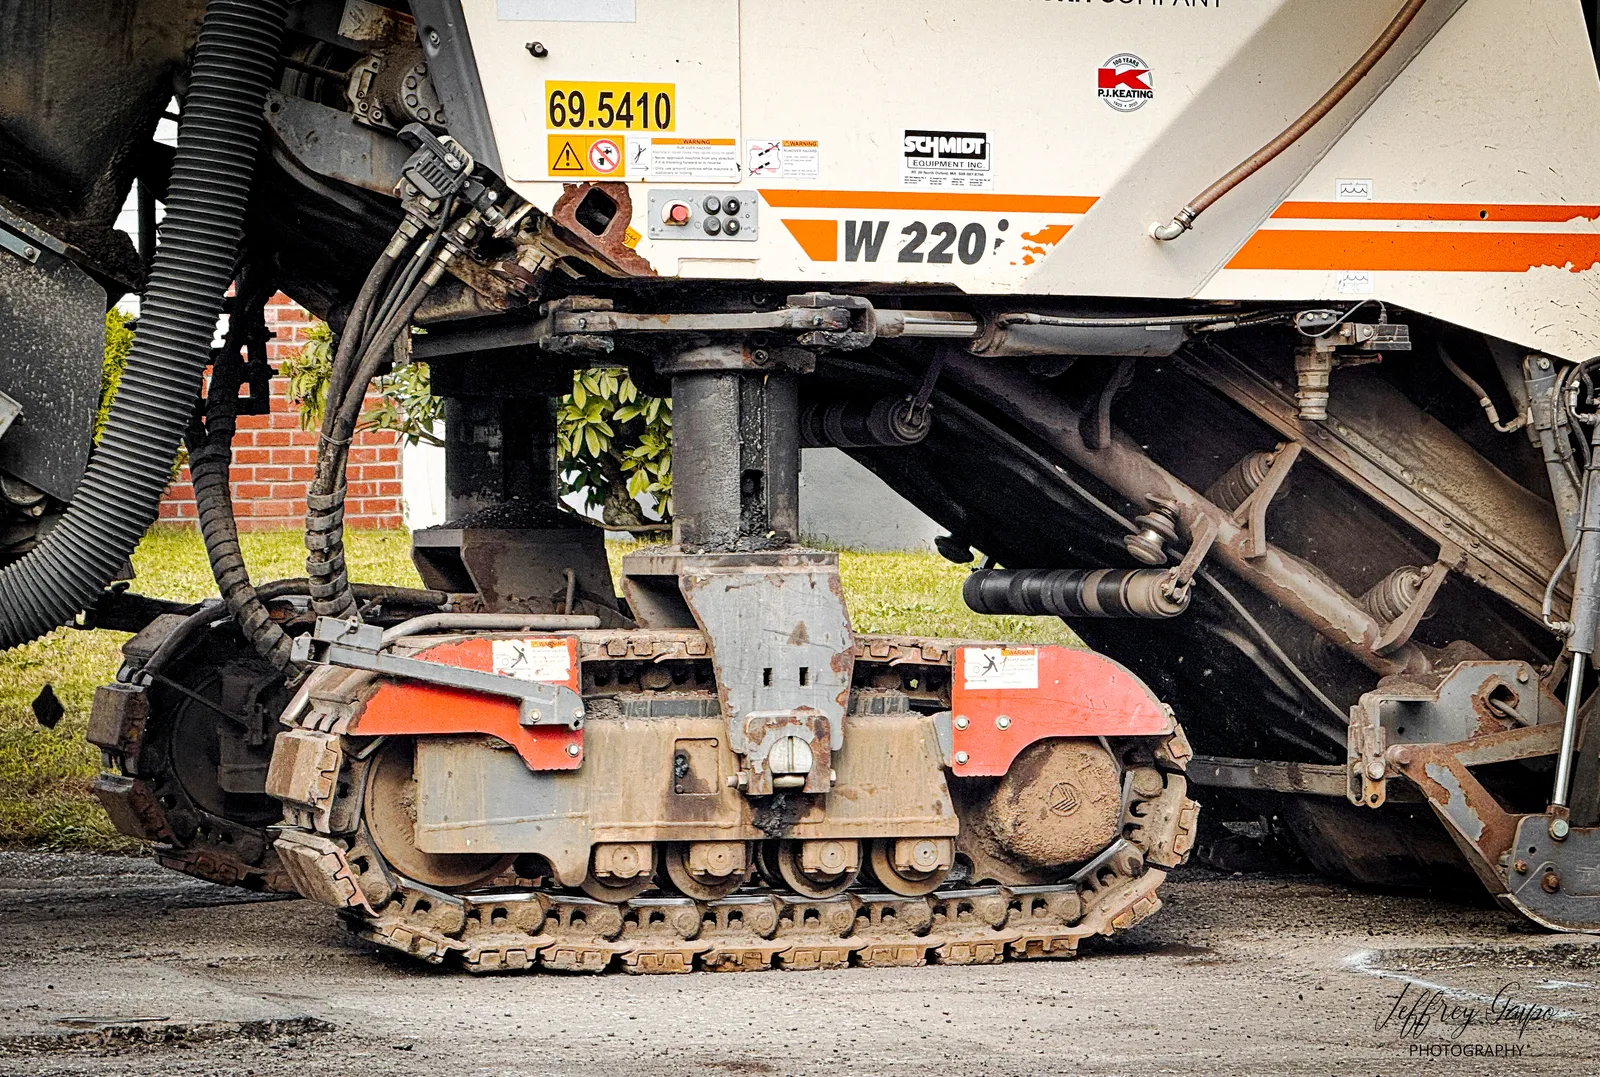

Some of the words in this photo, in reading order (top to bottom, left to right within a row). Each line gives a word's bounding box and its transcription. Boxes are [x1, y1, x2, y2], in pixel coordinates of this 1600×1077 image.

[1113, 58, 1122, 66] 100
[1123, 57, 1139, 67] YEARS
[549, 90, 671, 130] 69.5410
[904, 135, 985, 158] SCHMIDT
[912, 160, 965, 168] EQUIPMENT
[967, 161, 986, 169] INC.
[845, 220, 890, 262] W
